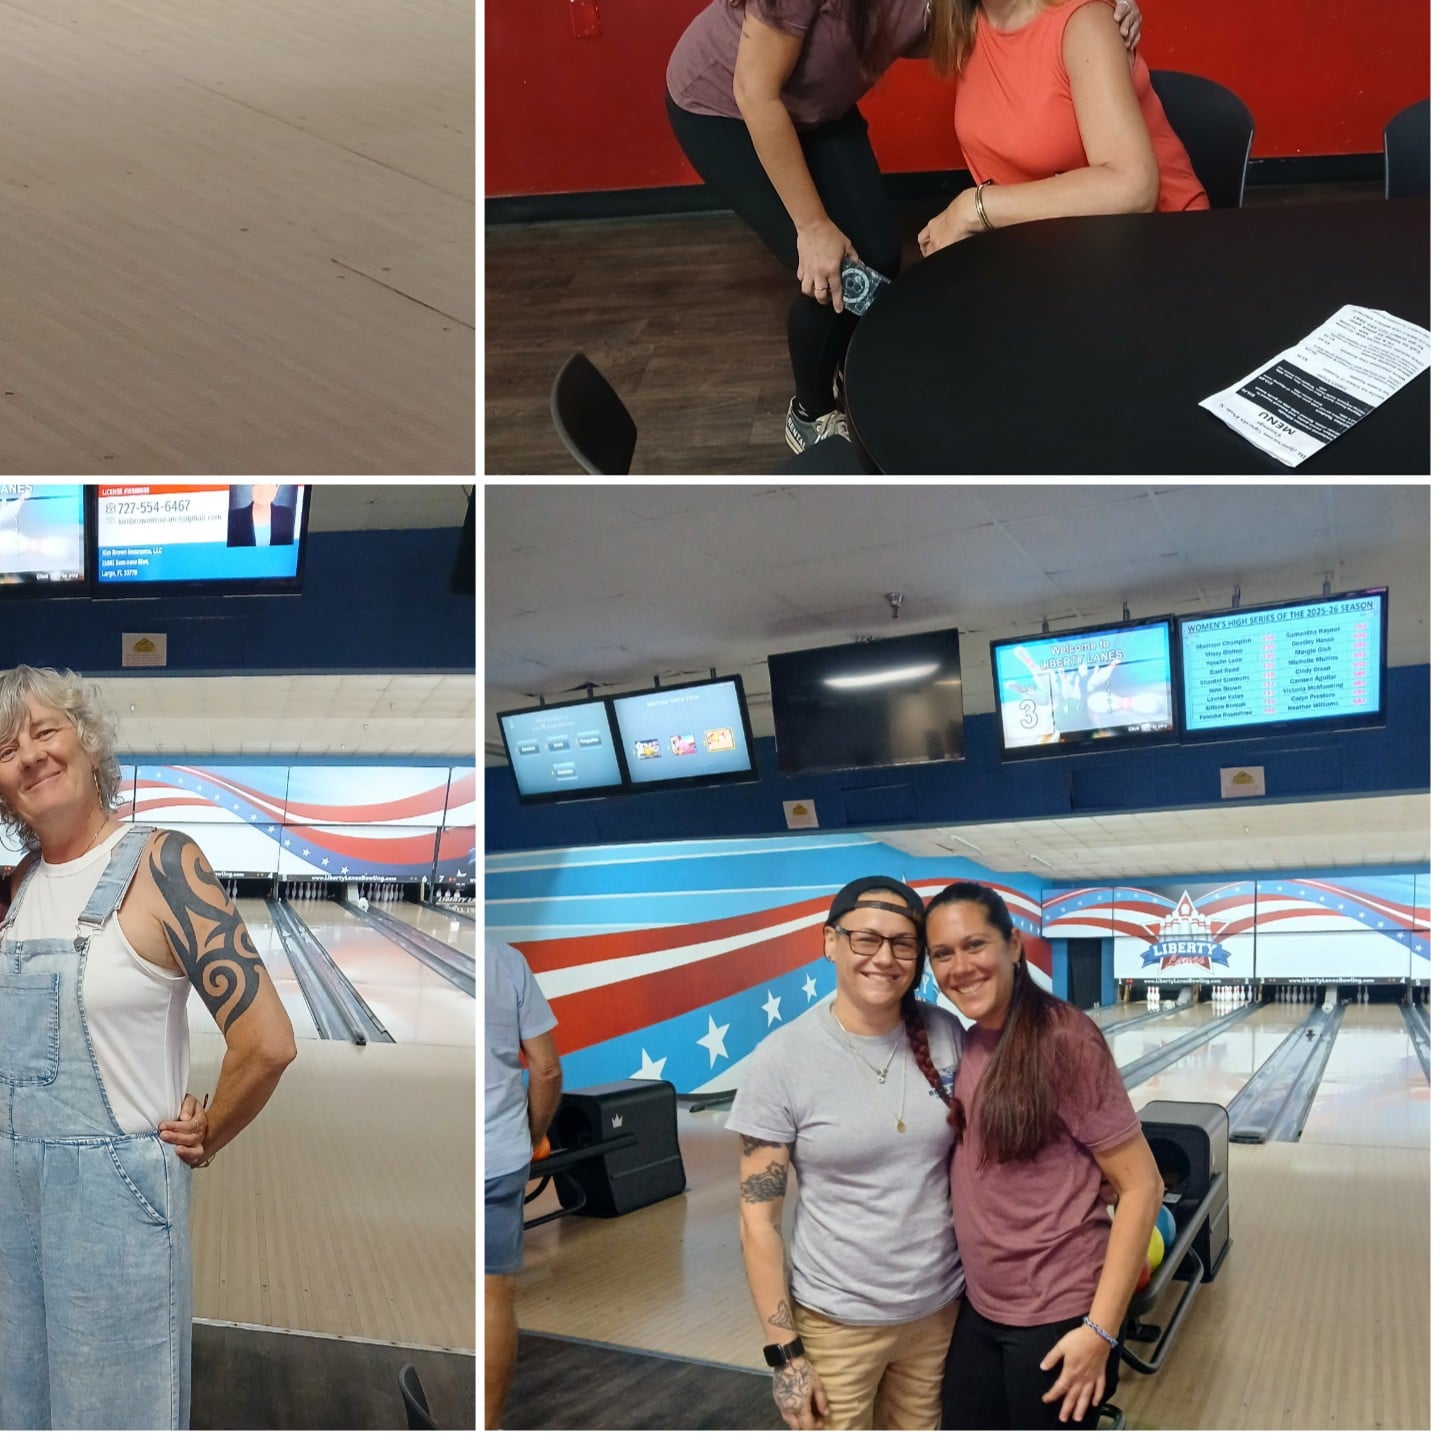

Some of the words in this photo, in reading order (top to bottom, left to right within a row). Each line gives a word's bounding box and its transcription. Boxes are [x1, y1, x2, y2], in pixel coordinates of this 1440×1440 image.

[1258, 411, 1296, 435] MENU
[118, 500, 191, 515] 727-554-6467
[1187, 620, 1227, 633] WOMEN'S
[1228, 617, 1248, 627] HIGH
[1249, 615, 1275, 625] SERIES
[1290, 610, 1305, 618] THE
[1307, 607, 1339, 616] 2025-26
[1342, 601, 1374, 611] SEASON
[1051, 641, 1097, 655] Welcome
[1098, 639, 1110, 649] to
[1040, 655, 1084, 670] LIBERTY
[1087, 650, 1123, 663] LANES
[1019, 698, 1039, 729] 3
[312, 874, 397, 883] www.LibertyLanesBowling.com
[439, 875, 445, 883] 7
[1153, 942, 1217, 957] LIBERTY
